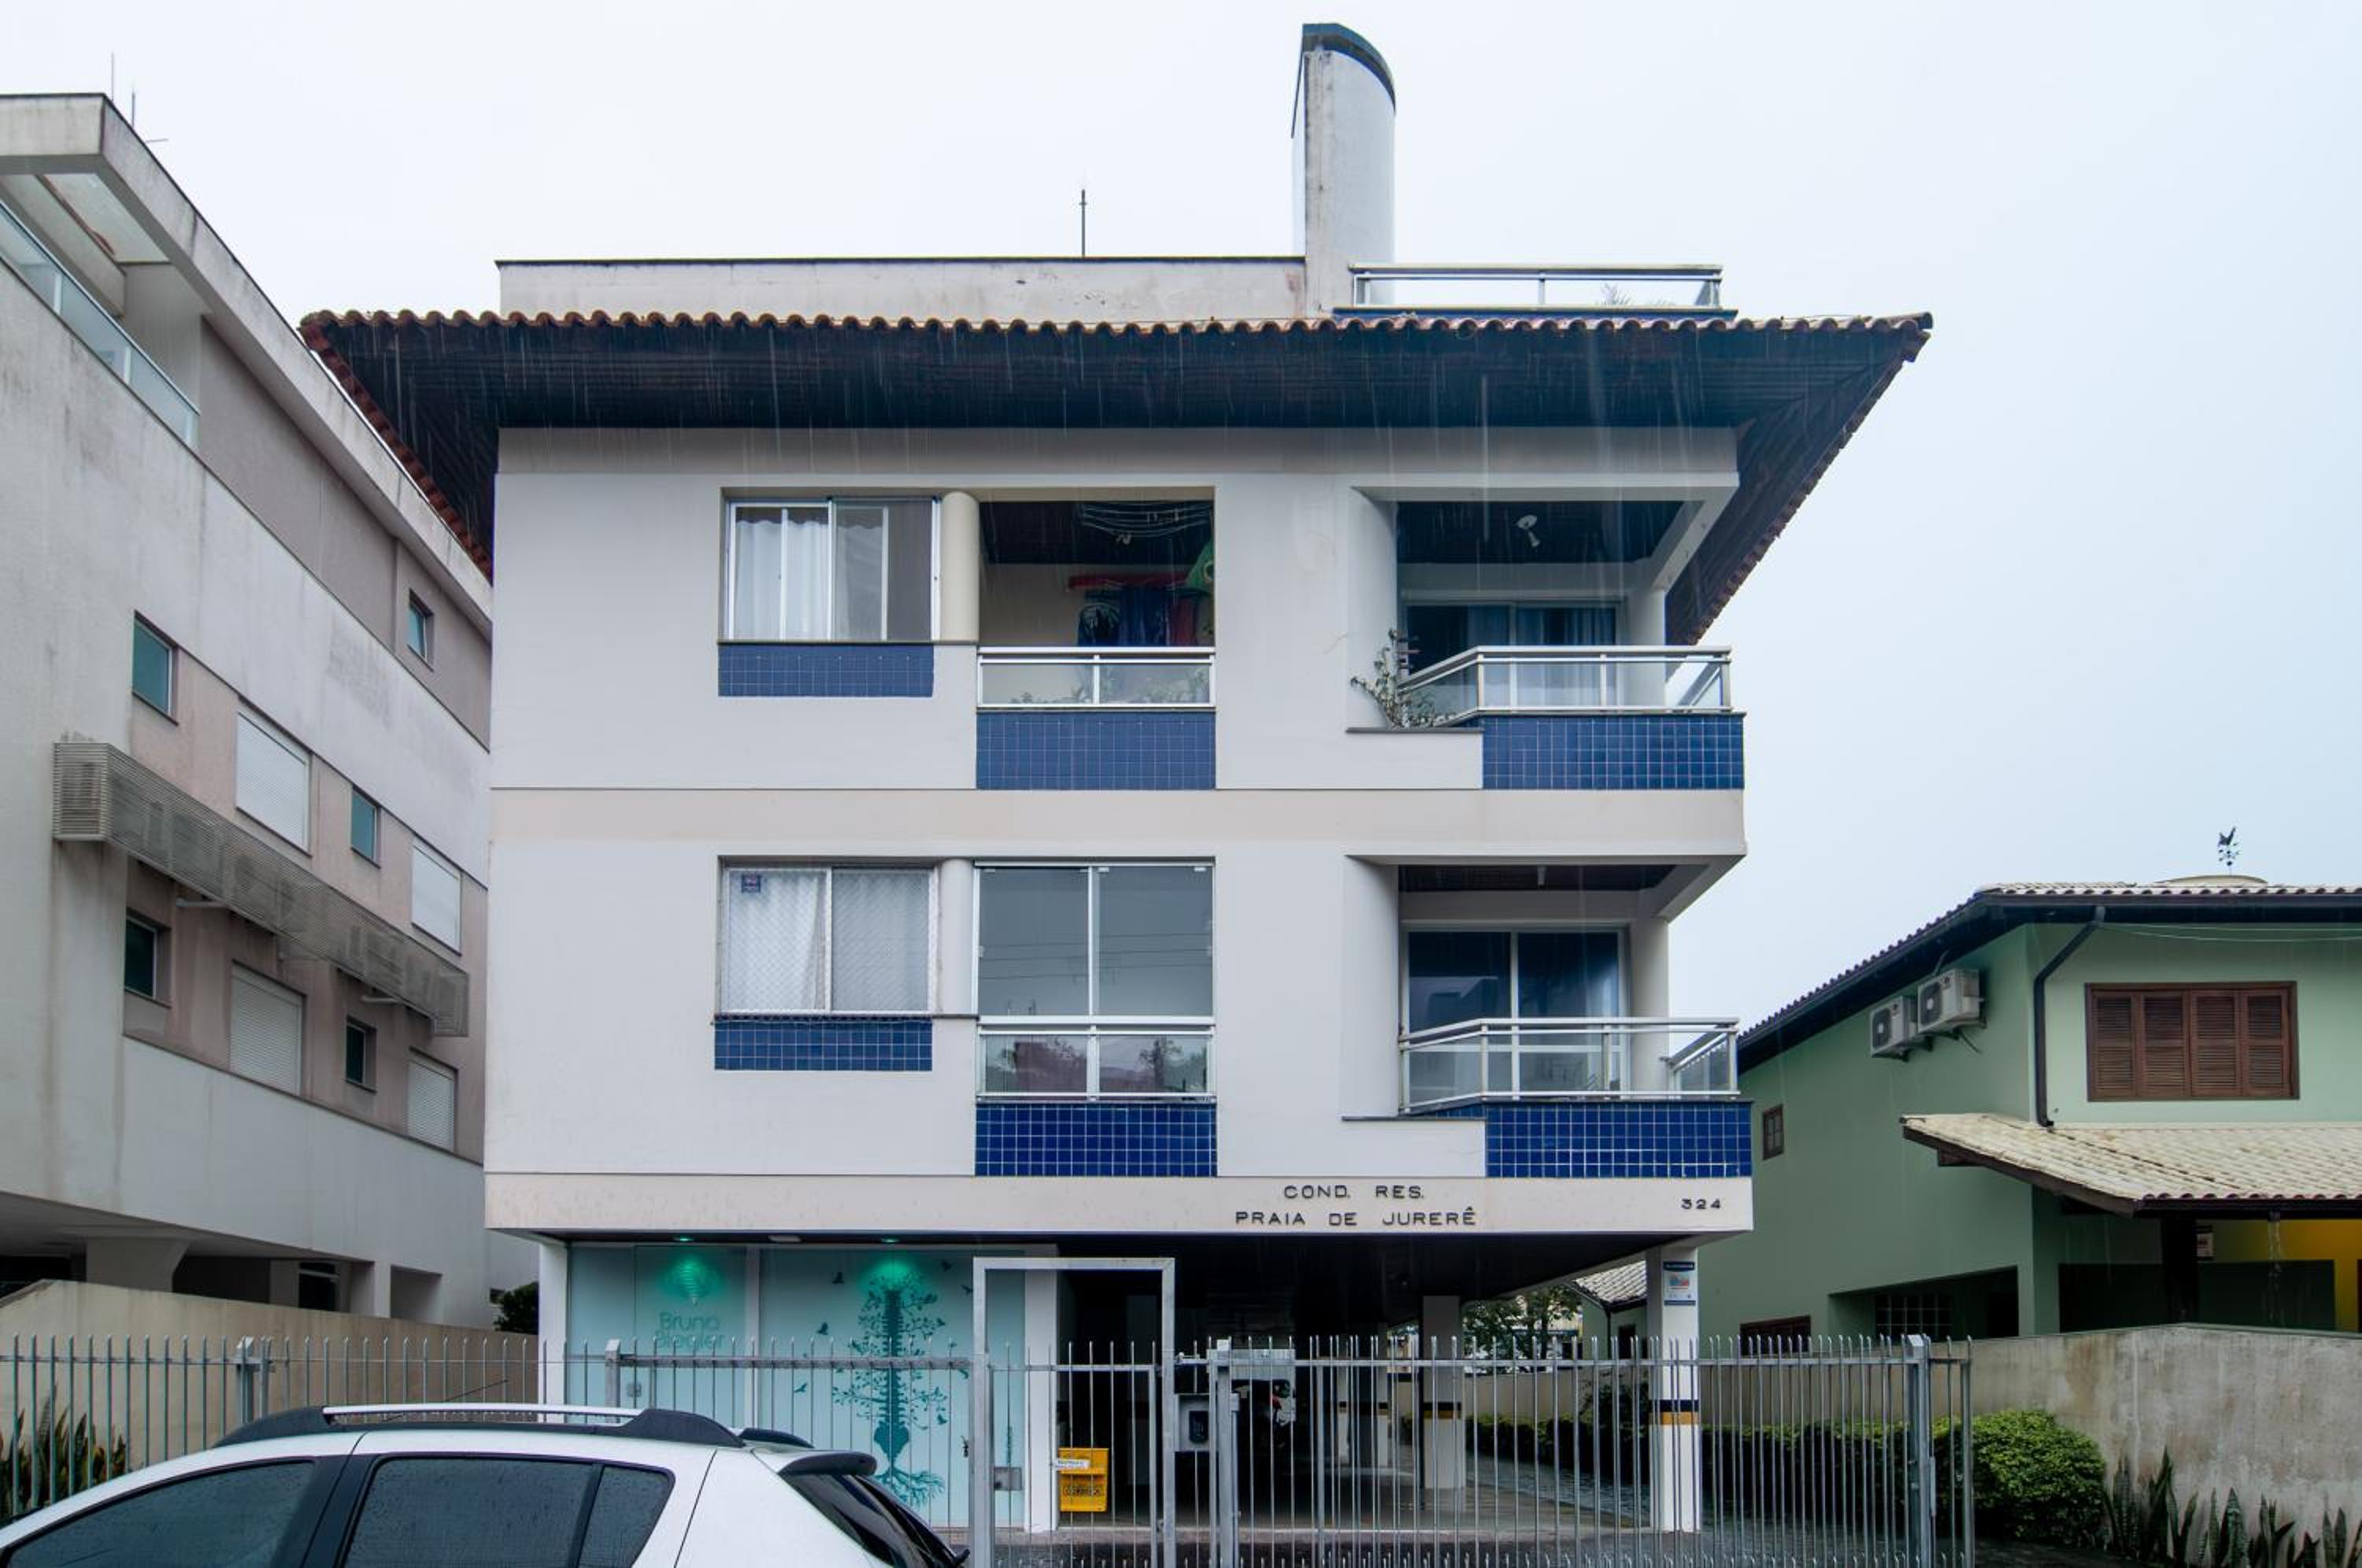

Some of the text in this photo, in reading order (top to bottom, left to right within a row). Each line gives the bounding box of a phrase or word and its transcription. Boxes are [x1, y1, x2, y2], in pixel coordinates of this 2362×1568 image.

[1283, 1184, 1423, 1199] COND. RES.
[1681, 1198, 1721, 1210] 324
[1235, 1206, 1476, 1226] PRAIA DE JURERÊ
[659, 1311, 719, 1331] Bruno
